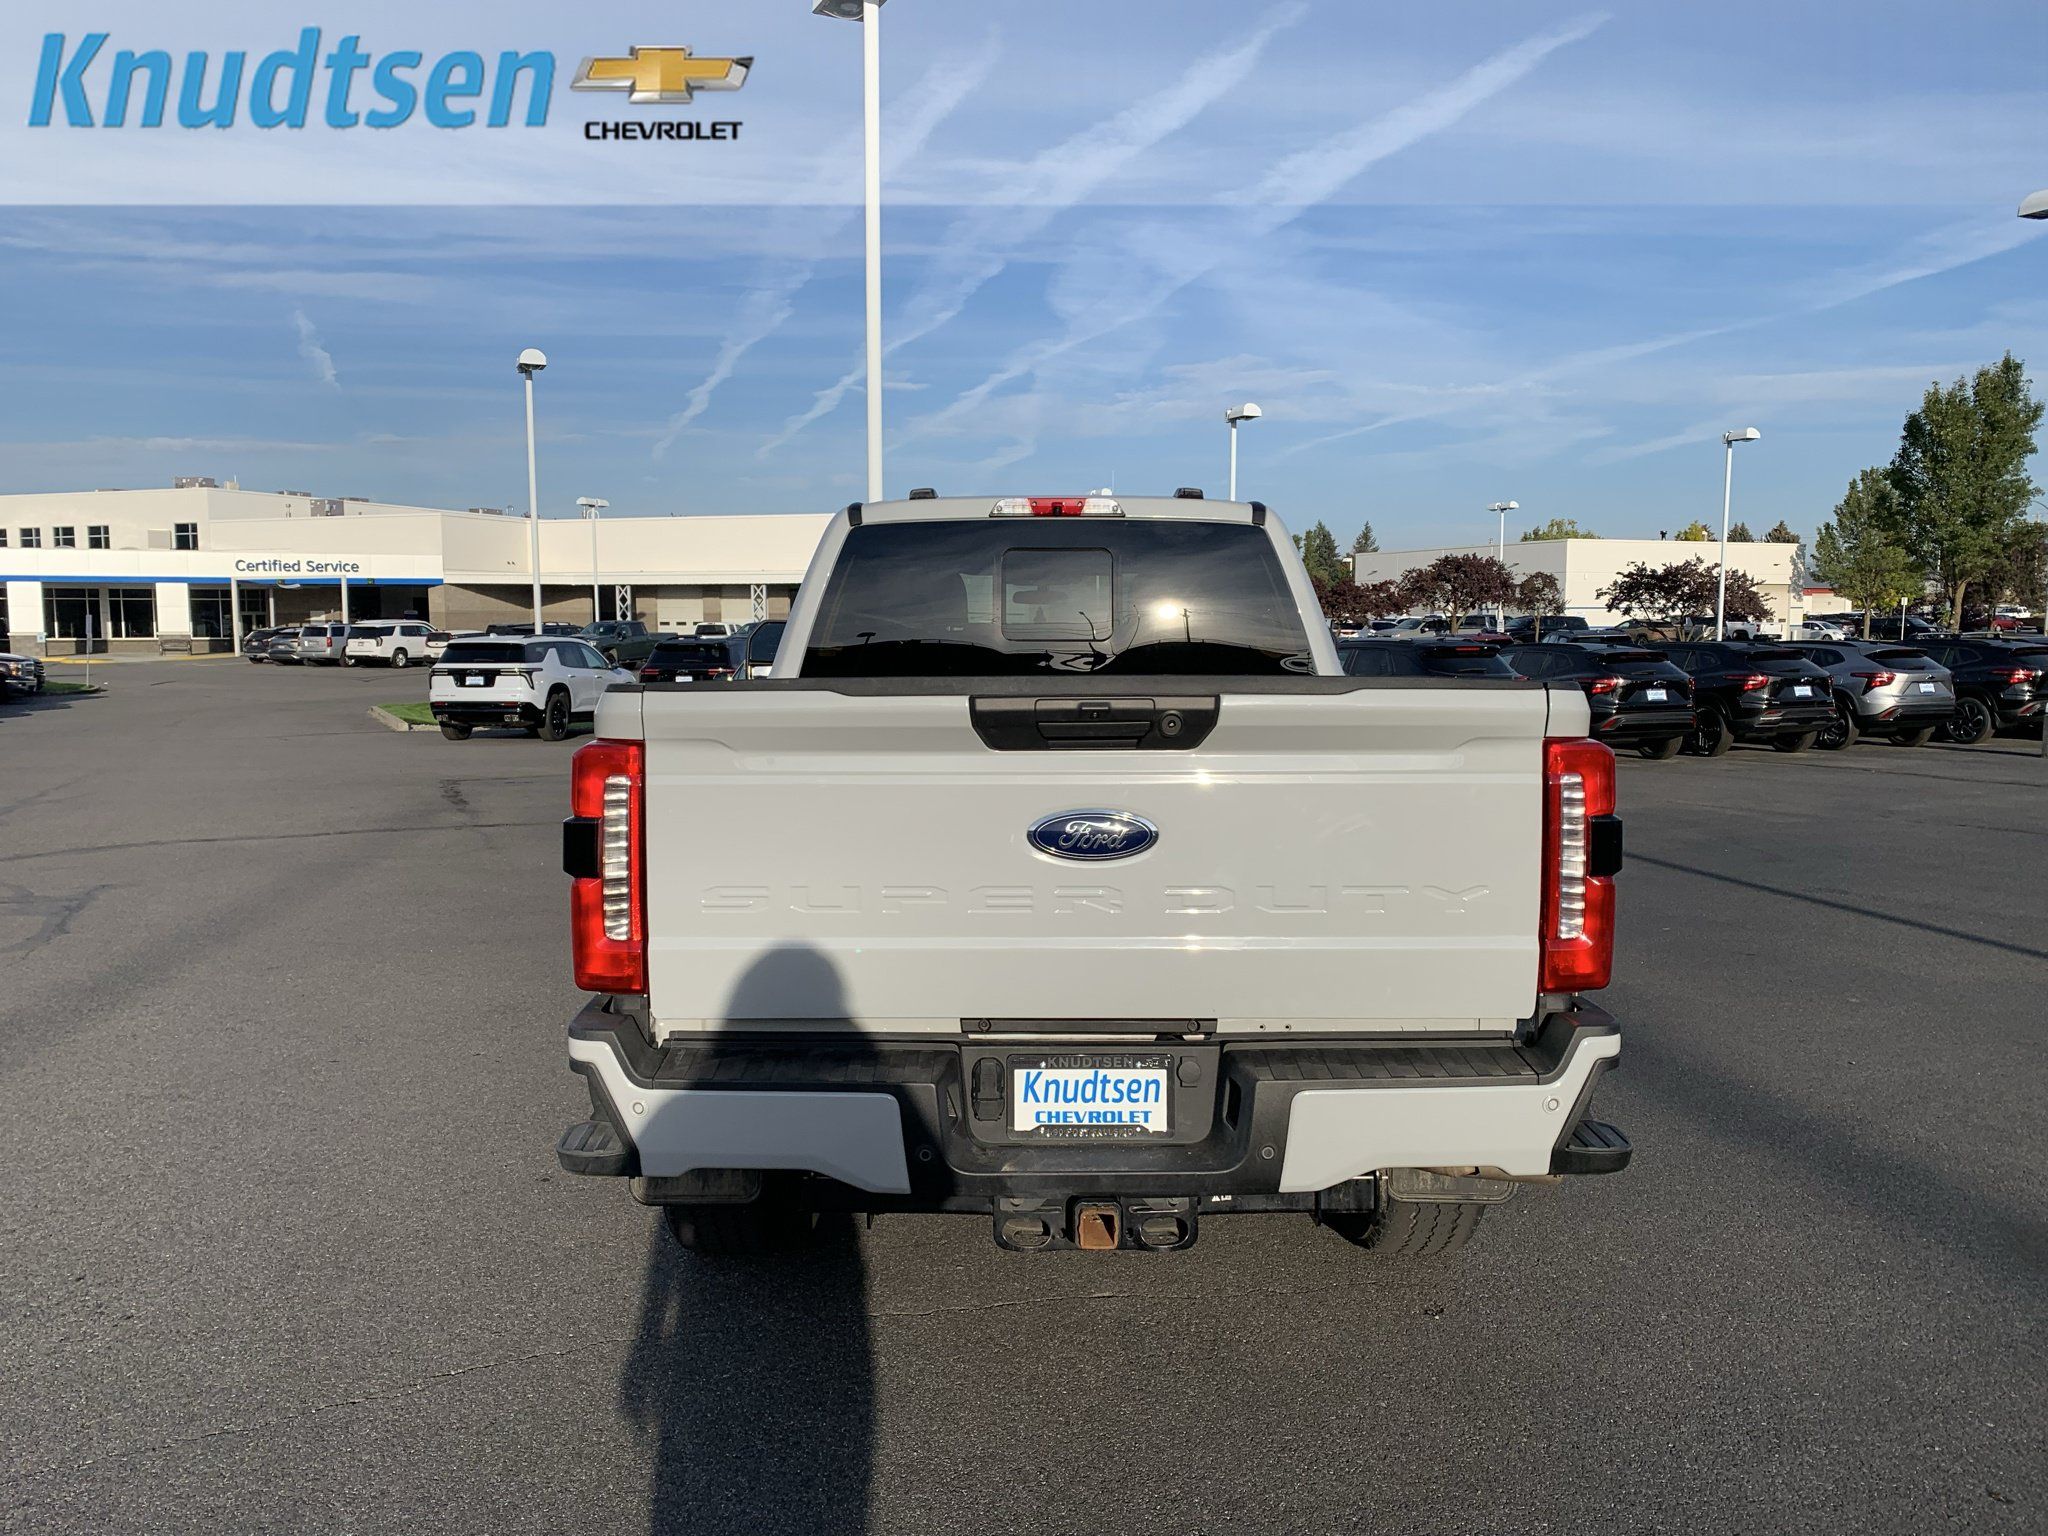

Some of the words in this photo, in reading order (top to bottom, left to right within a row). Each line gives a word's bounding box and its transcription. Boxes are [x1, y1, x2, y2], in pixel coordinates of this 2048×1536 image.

[235, 559, 301, 572] Certified
[306, 560, 360, 573] Service
[1058, 819, 1130, 850] Ford
[701, 885, 1123, 914] SUPER
[1164, 885, 1490, 914] DUTY
[1047, 1056, 1135, 1069] KNUDTSEN
[1022, 1070, 1161, 1104] Knudtsen
[1034, 1110, 1152, 1124] CHEVROLET
